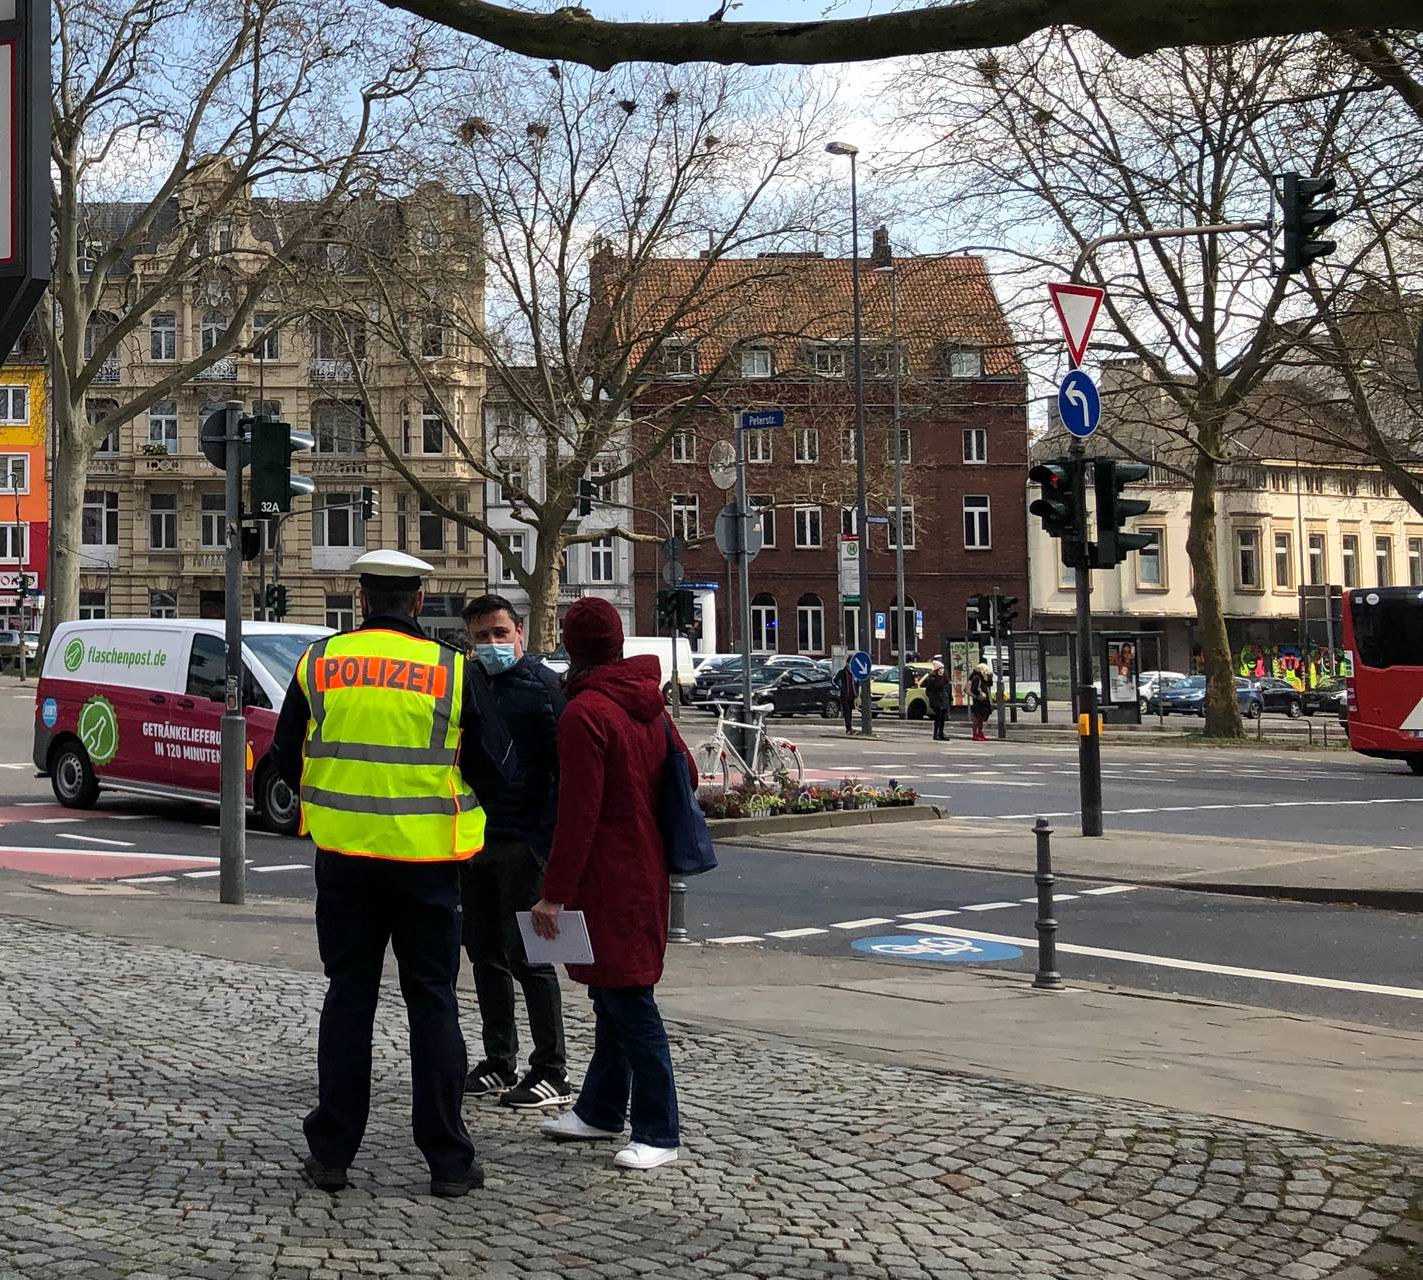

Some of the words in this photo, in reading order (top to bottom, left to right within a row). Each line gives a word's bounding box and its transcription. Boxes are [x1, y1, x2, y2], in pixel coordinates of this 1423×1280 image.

[749, 414, 777, 426] Peterstr.
[261, 501, 280, 513] 32A
[87, 645, 167, 669] flaschenpost.de
[324, 656, 435, 696] POLIZEI
[142, 720, 222, 746] GETRÄNKELIEFERU
[154, 741, 164, 757] IN
[166, 743, 181, 759] 120
